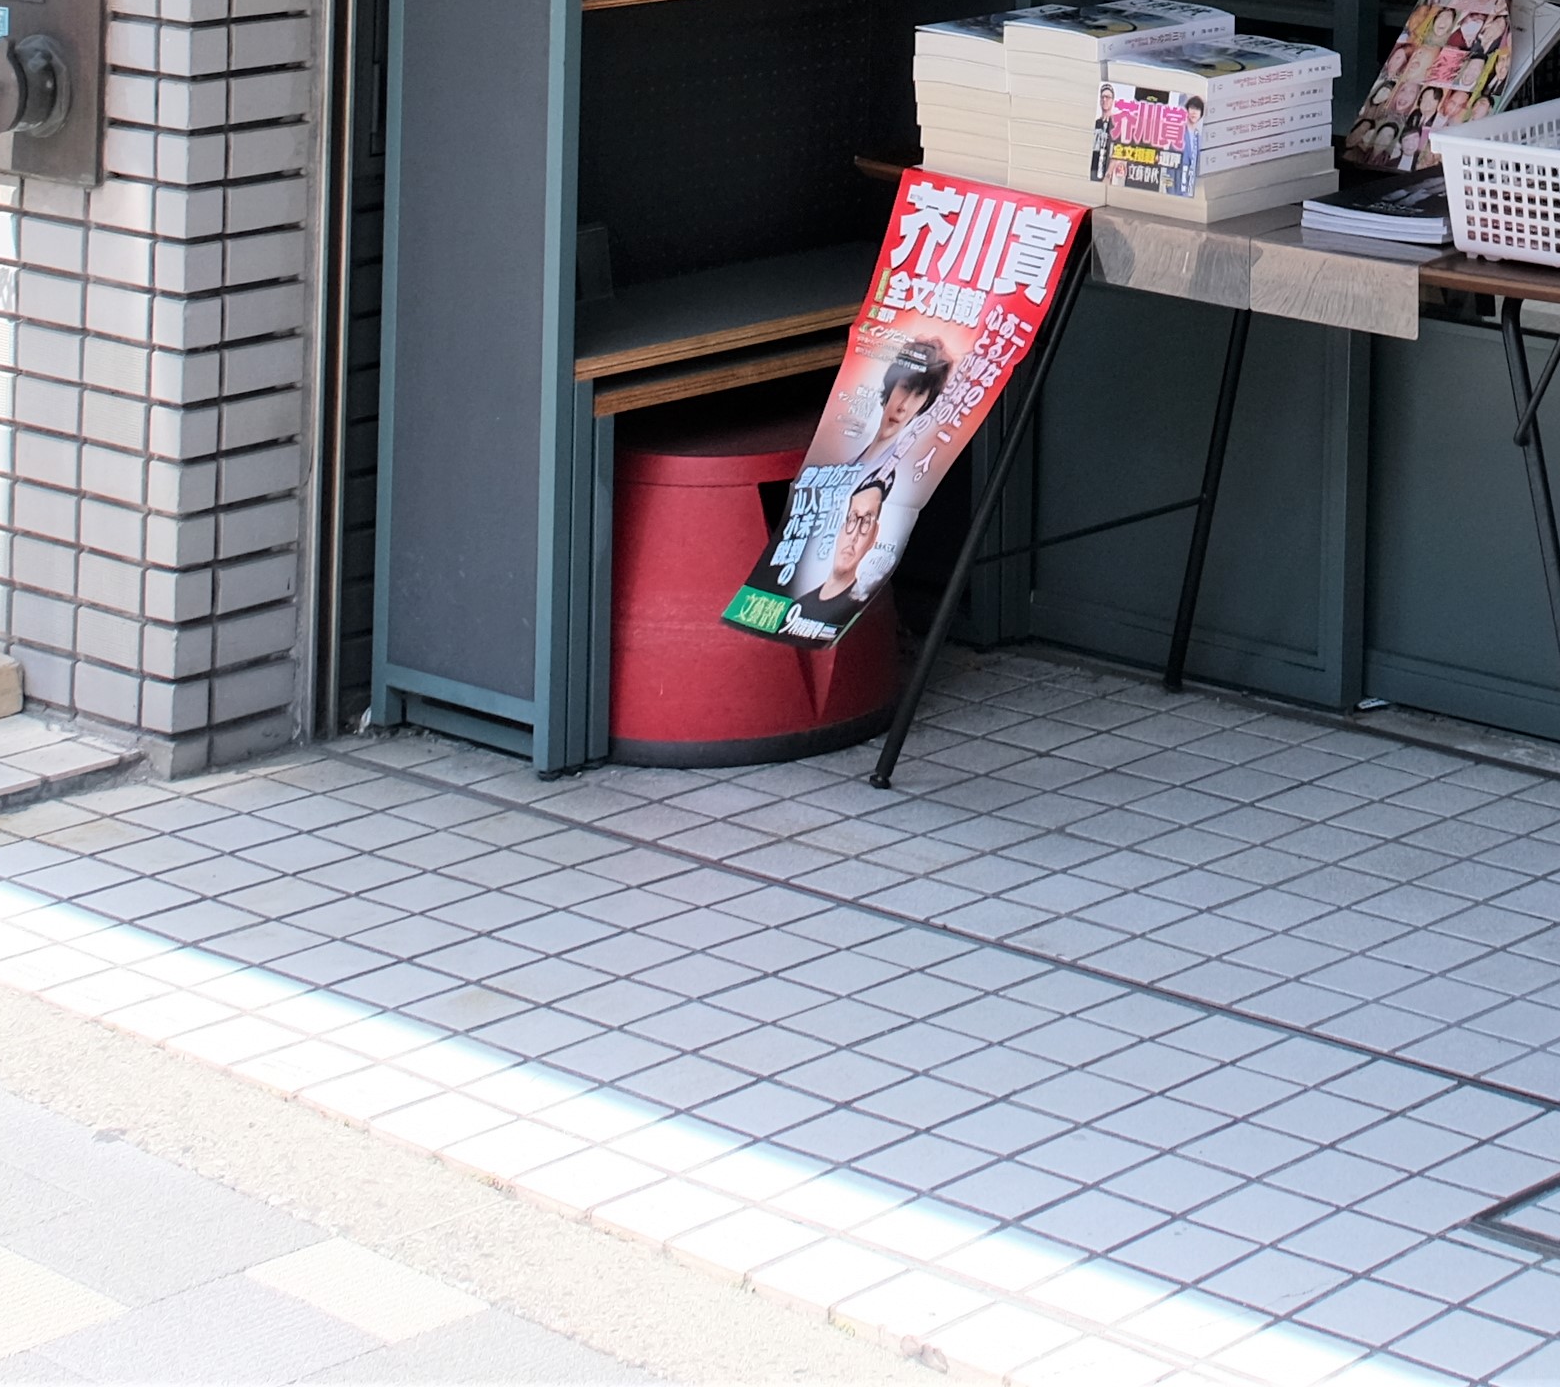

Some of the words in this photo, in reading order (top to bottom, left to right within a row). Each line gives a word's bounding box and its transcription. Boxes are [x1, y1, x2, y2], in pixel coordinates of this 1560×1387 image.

[1110, 99, 1189, 152] 芥川賞
[890, 180, 1073, 305] 芥川賞
[884, 272, 989, 329] 全文掲載
